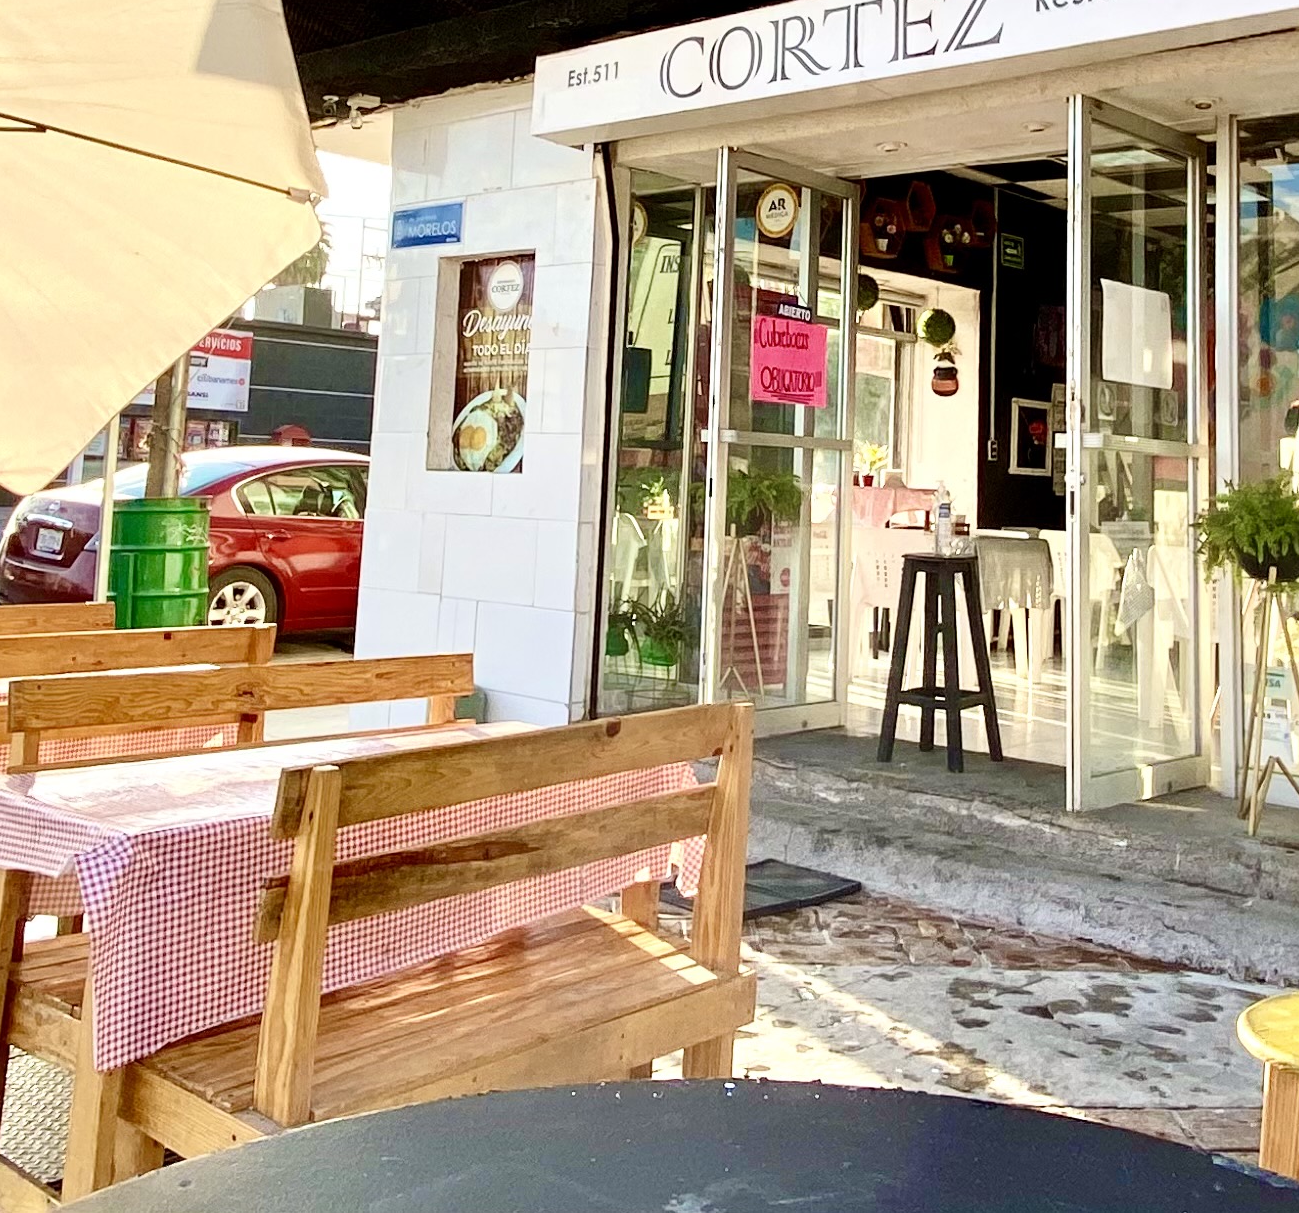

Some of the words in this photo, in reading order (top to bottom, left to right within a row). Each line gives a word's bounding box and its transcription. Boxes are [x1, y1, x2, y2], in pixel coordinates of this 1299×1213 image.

[567, 60, 620, 89] Est.511
[408, 220, 457, 237] MORELOS
[778, 304, 811, 321] ABIERTO
[199, 335, 242, 352] ERVICIOS
[472, 344, 498, 356] TODO
[500, 343, 513, 354] EL
